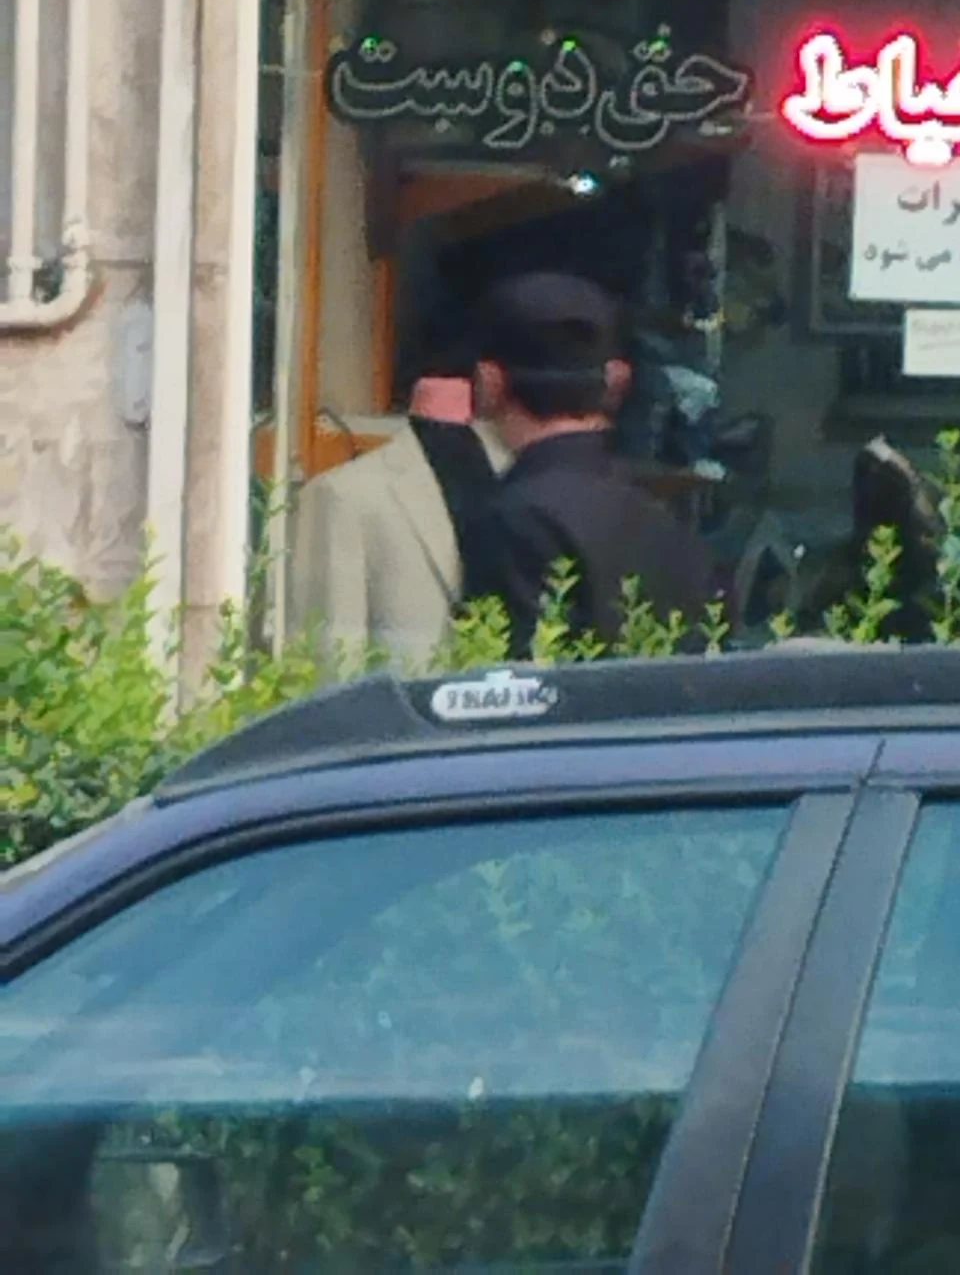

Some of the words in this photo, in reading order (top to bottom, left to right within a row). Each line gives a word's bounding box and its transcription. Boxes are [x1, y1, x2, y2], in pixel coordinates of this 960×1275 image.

[332, 37, 597, 148] دوست
[596, 37, 748, 149] حق
[914, 247, 953, 273] می
